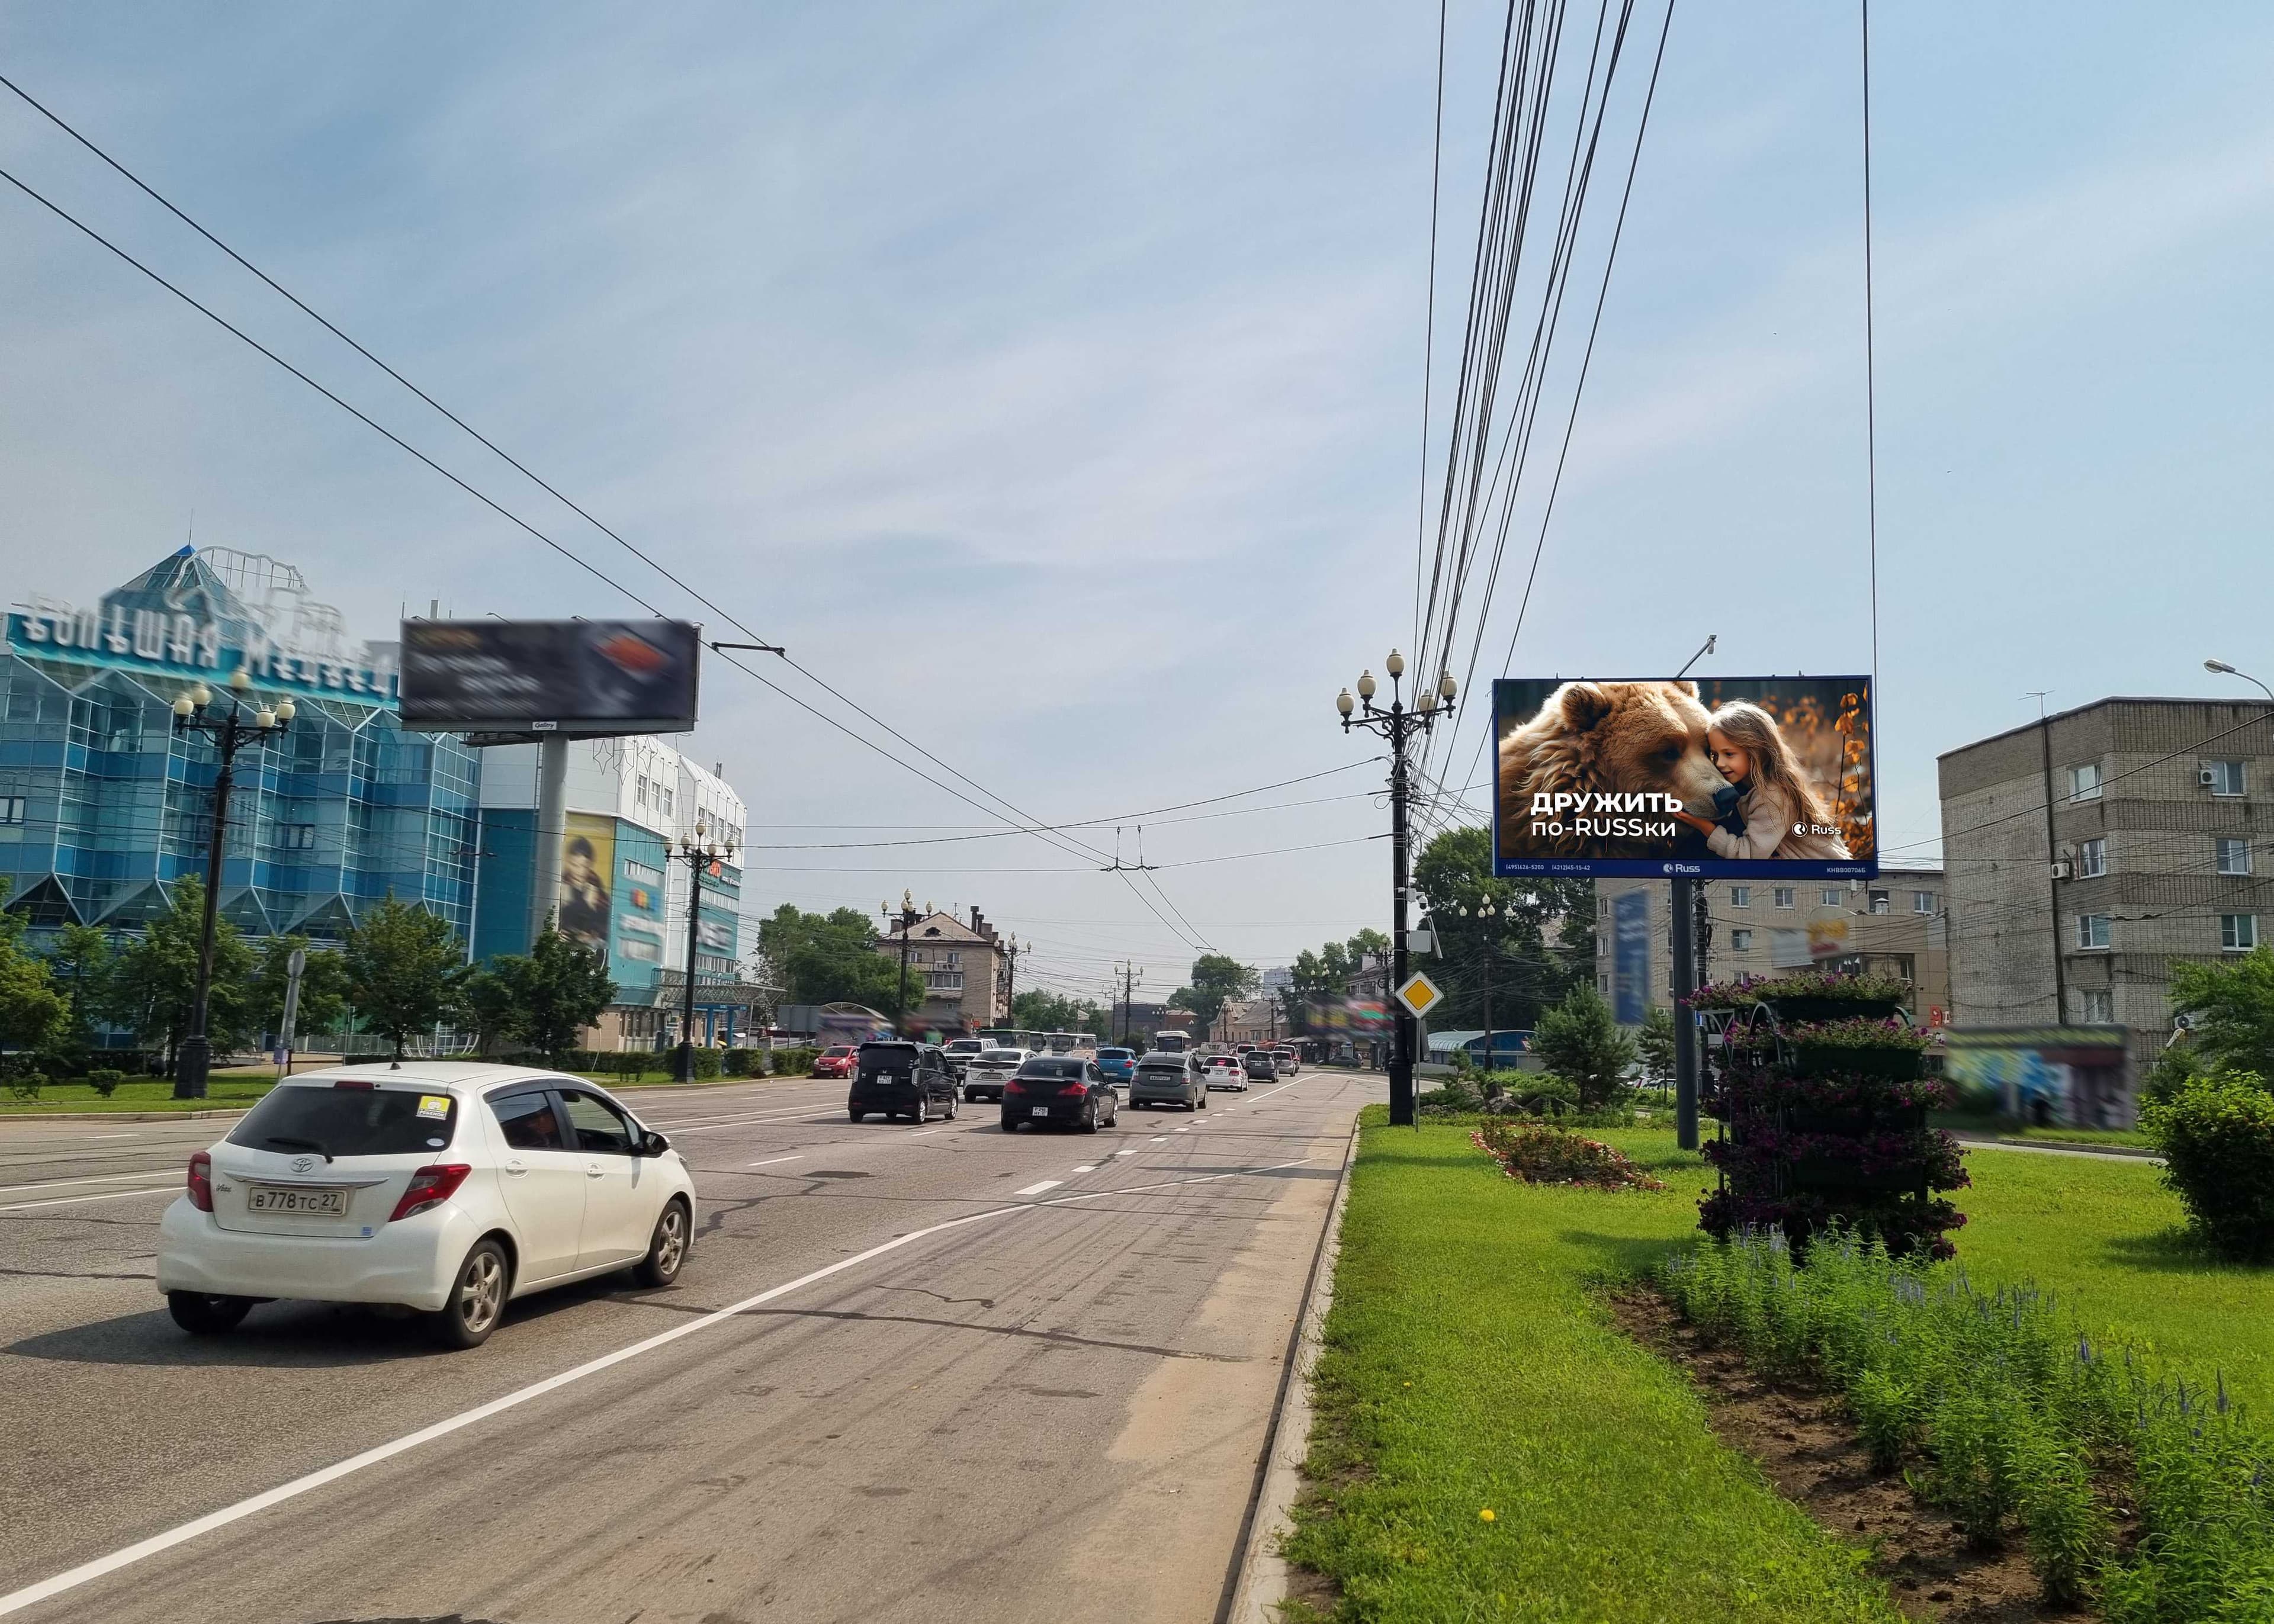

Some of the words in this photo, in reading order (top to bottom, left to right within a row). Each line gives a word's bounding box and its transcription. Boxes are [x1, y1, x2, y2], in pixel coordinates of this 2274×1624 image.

[1531, 793, 1683, 816] ДРУЖИТЬ
[1532, 818, 1676, 837] по-RUSSки
[1812, 824, 1842, 834] Russ
[1675, 864, 1701, 873] Russ
[322, 1194, 338, 1207] 27
